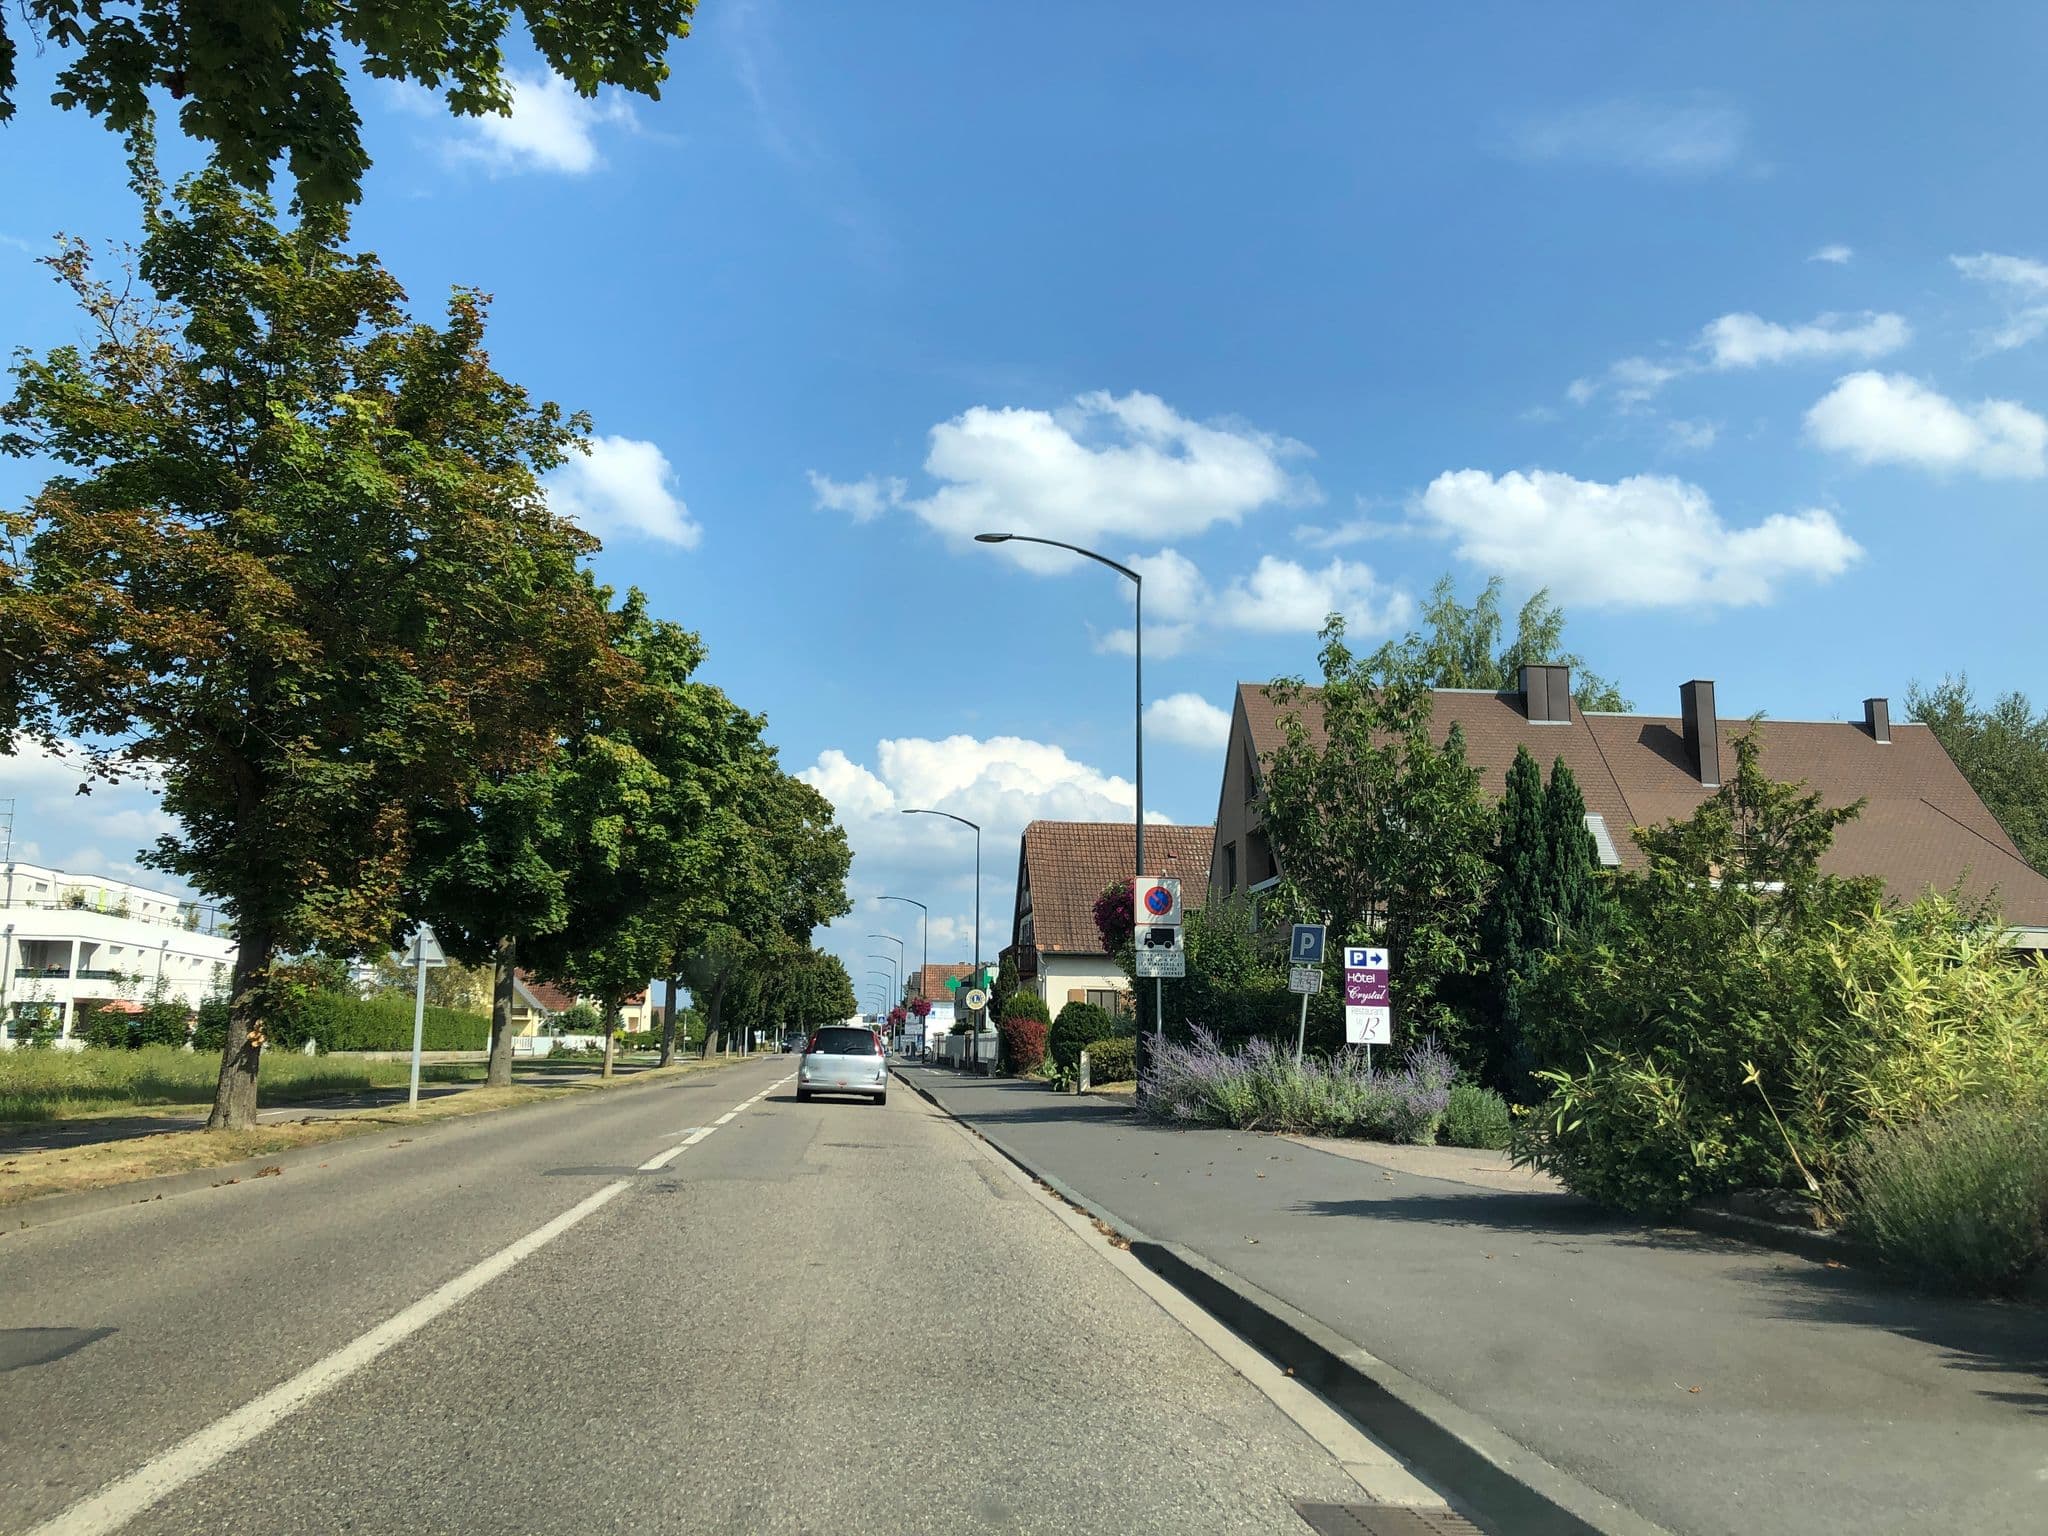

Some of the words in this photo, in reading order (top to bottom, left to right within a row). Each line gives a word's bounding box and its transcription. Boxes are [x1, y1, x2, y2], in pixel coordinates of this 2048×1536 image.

[1300, 932, 1315, 955] P
[1353, 952, 1364, 964] P
[1347, 972, 1376, 983] Hôtel
[1347, 985, 1387, 1004] Crystal
